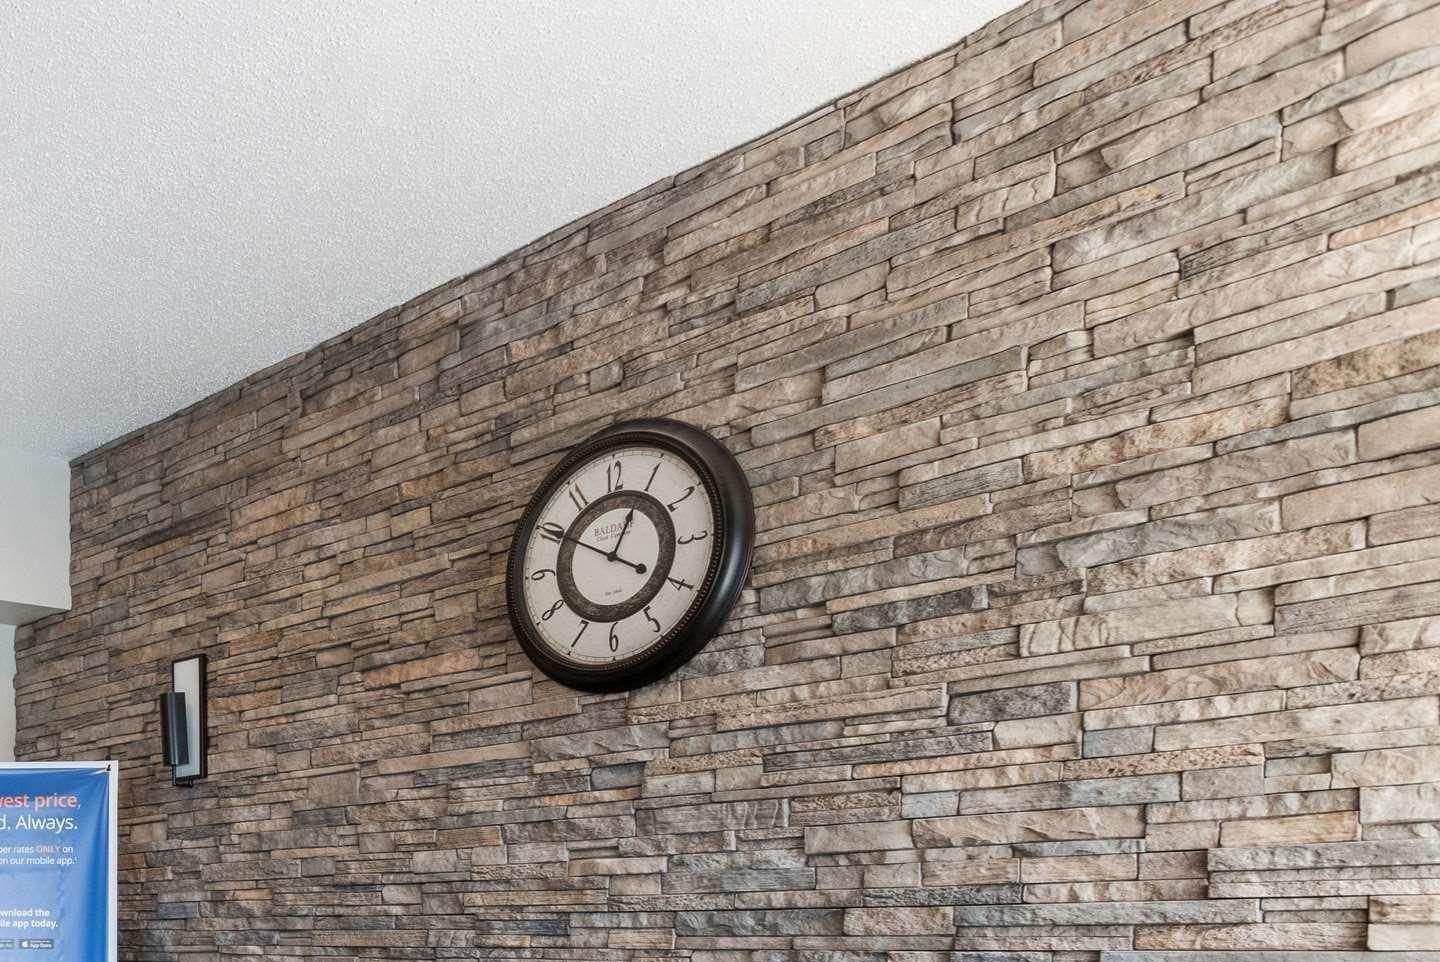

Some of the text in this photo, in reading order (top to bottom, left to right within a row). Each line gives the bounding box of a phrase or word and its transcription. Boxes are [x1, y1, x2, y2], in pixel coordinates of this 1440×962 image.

[606, 460, 624, 493] 12
[644, 463, 661, 492] 1
[569, 482, 590, 512] 11
[667, 486, 696, 512] 2
[539, 522, 565, 544] 10
[678, 530, 708, 545] 3
[531, 569, 556, 581] 9
[668, 577, 694, 591] 4
[542, 599, 564, 620] 8
[643, 606, 660, 633] 5
[571, 620, 589, 647] 7
[610, 622, 619, 652] 6
[34, 793, 81, 812] price,
[15, 814, 78, 834] Always.
[14, 846, 34, 854] rates
[35, 845, 60, 854] ONLY
[62, 846, 74, 854] on
[26, 856, 55, 865] mobile
[35, 908, 50, 917] the
[12, 921, 29, 930] app
[31, 919, 59, 929] today.
